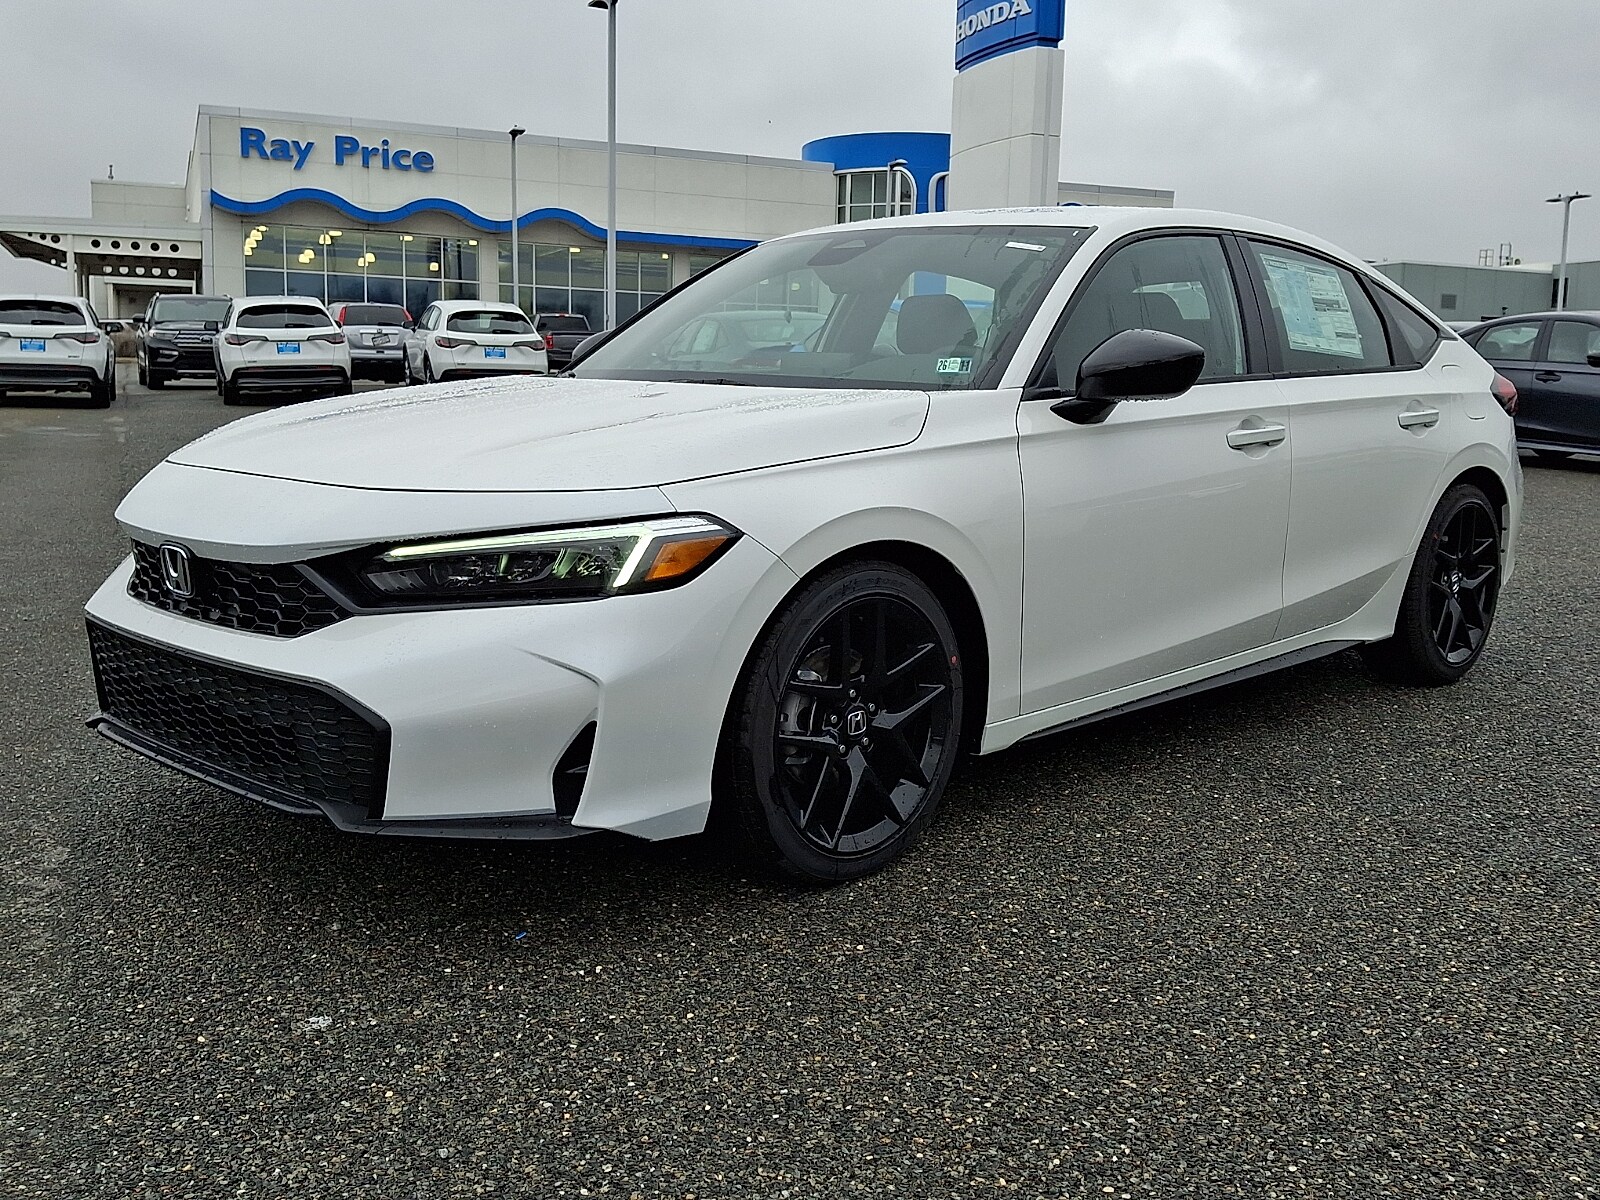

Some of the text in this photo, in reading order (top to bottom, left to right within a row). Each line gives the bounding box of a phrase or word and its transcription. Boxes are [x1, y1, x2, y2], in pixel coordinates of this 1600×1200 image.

[956, 0, 1032, 42] HONDA
[240, 127, 435, 172] Ray Price
[938, 360, 948, 371] 26
